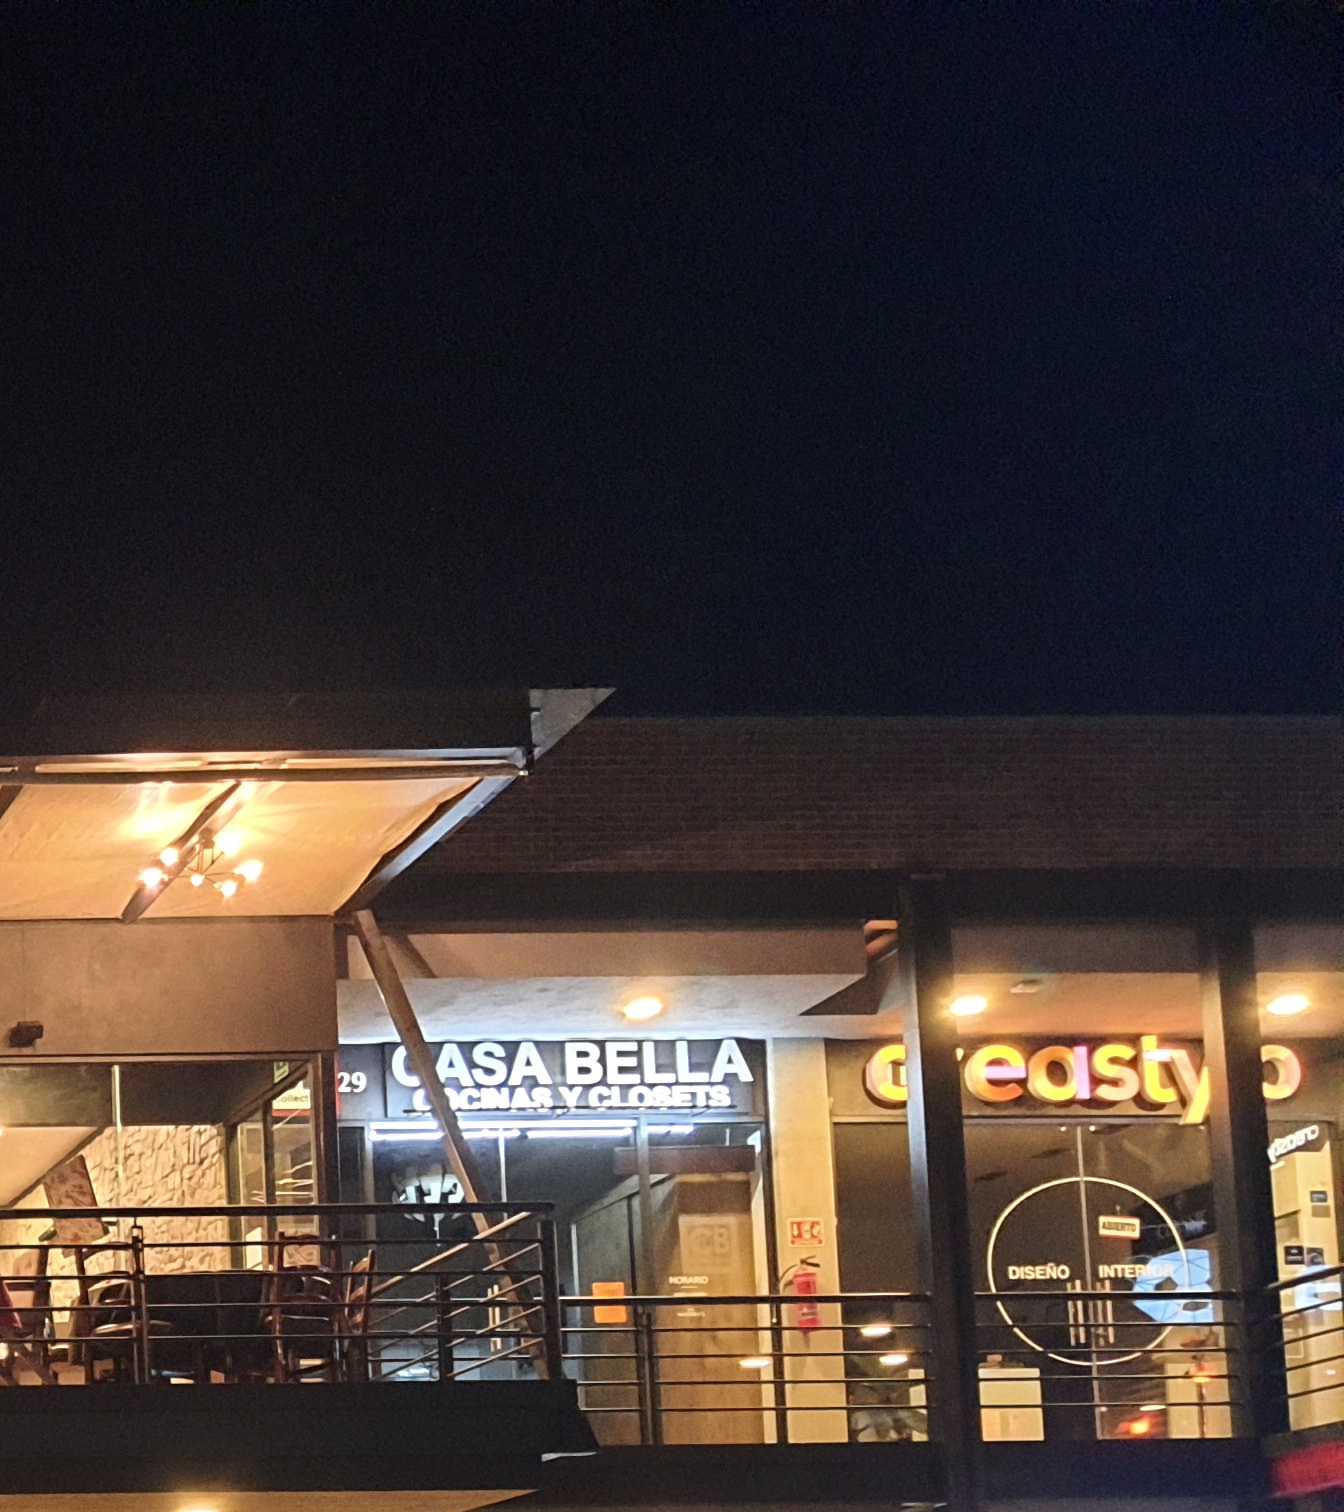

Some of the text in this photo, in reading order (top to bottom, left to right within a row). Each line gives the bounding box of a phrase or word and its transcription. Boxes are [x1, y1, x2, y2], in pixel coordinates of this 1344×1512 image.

[392, 1039, 754, 1088] CASA BELLA
[337, 1071, 368, 1094] 29
[558, 1086, 583, 1108] Y
[587, 1085, 731, 1108] CLOSETS
[1100, 1220, 1138, 1234] ABIERTO
[1007, 1262, 1175, 1281] DISEÑO INTERIOR
